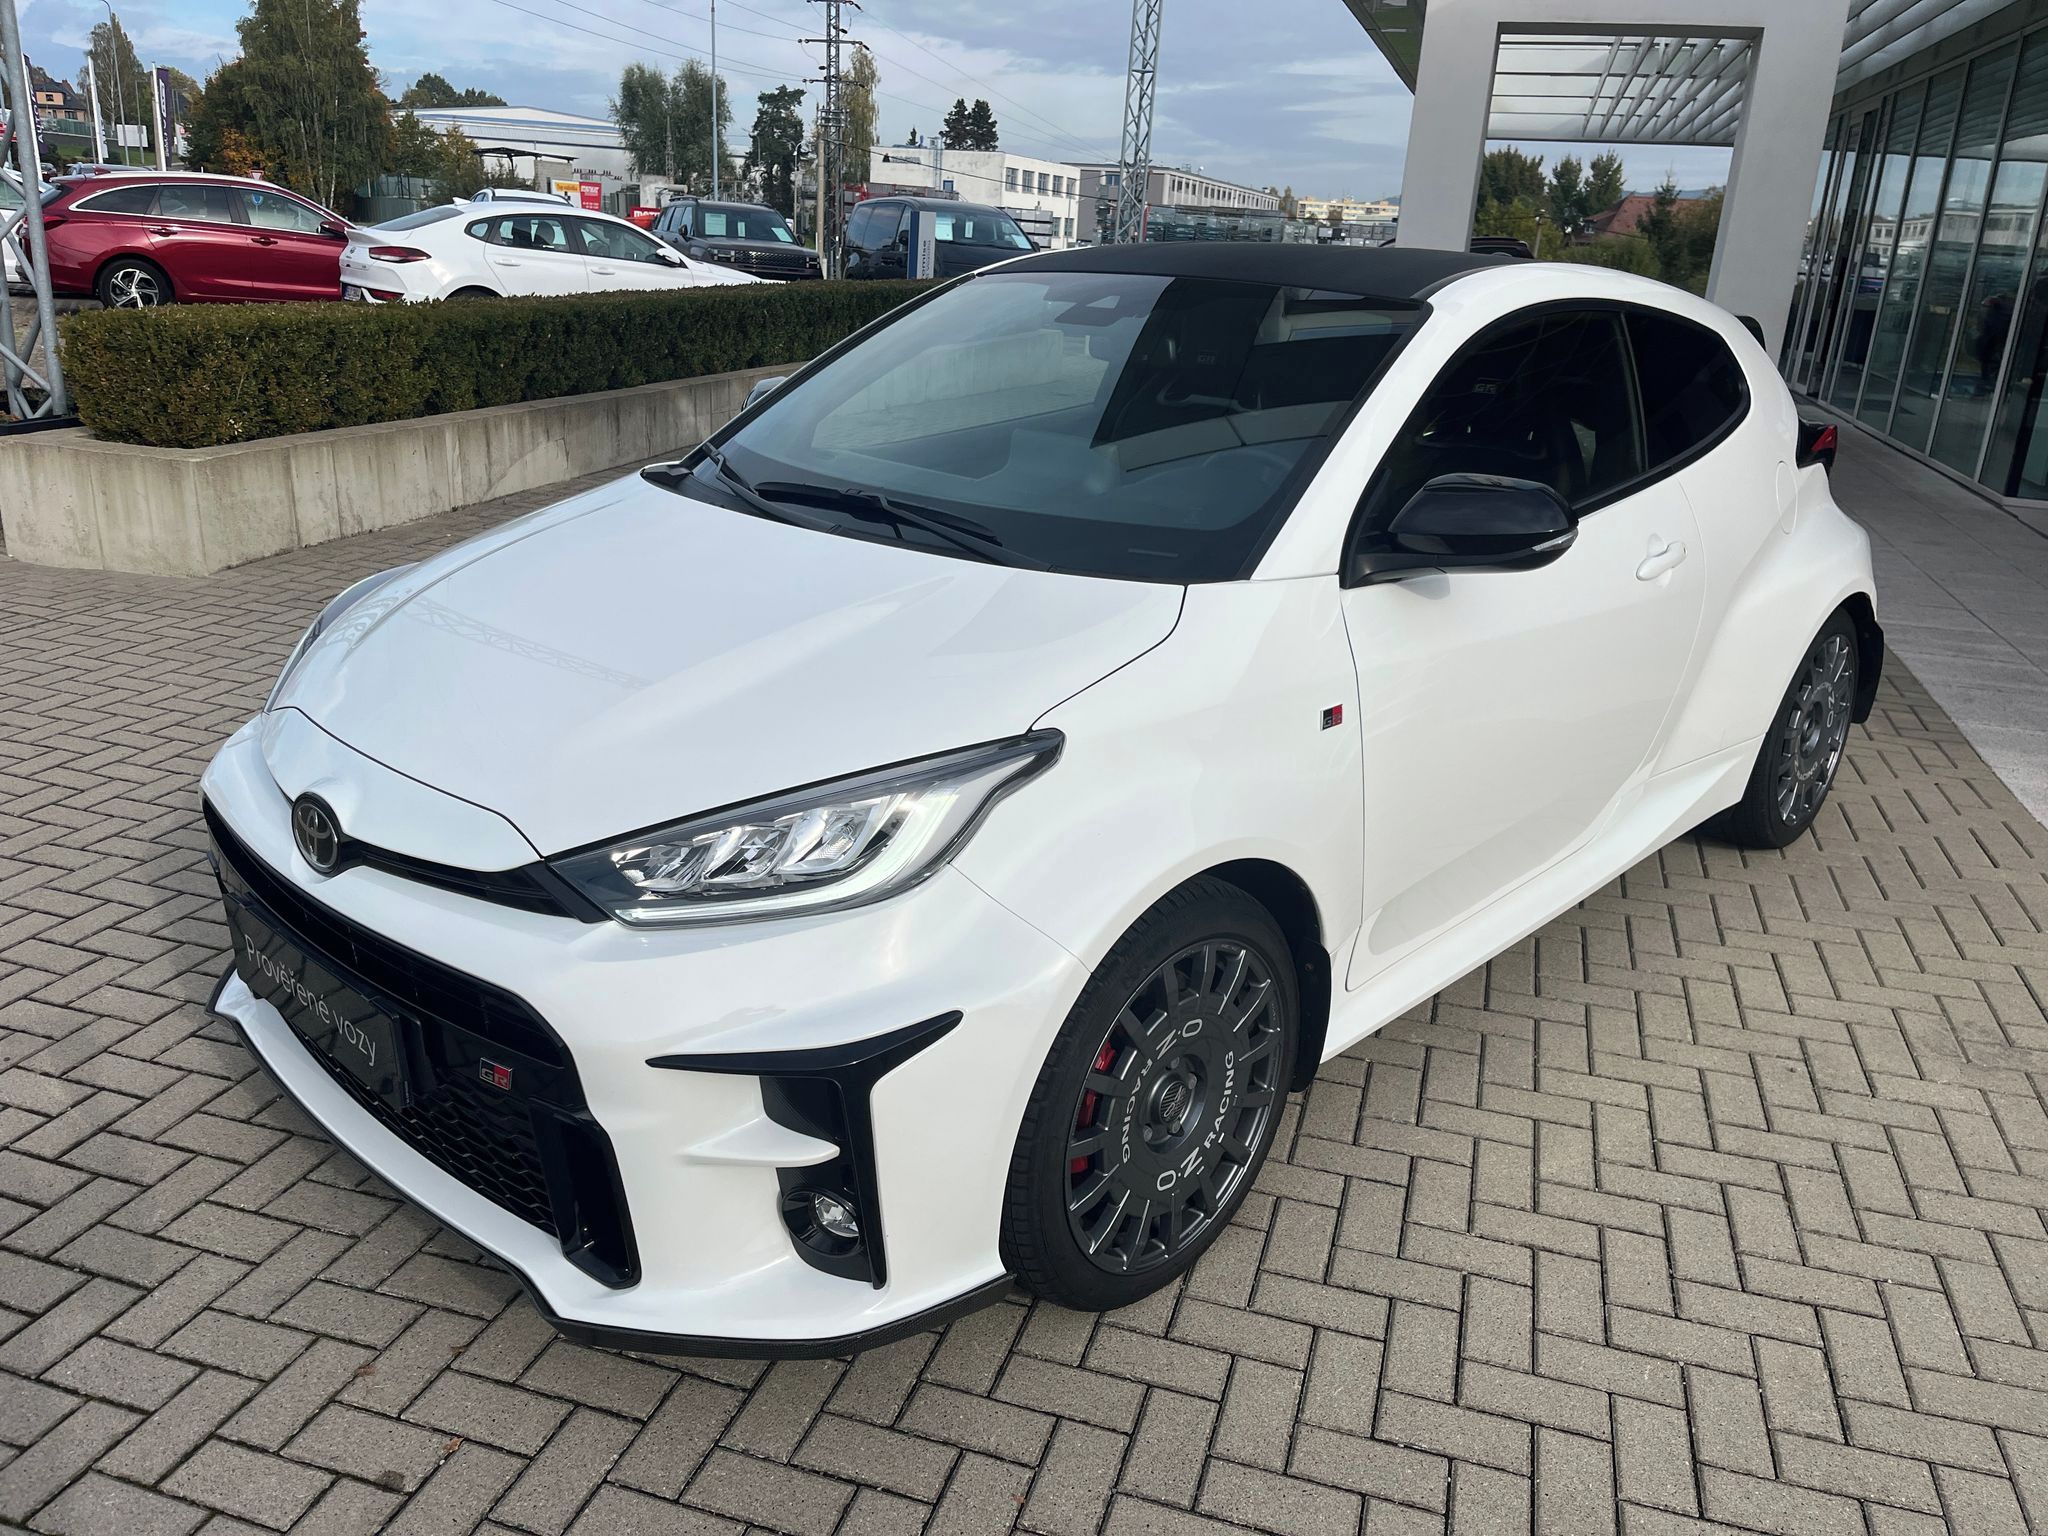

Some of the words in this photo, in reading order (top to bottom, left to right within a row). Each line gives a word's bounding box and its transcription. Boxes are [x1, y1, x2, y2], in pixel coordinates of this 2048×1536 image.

[245, 934, 330, 1023] Prověřené
[333, 1008, 377, 1067] vozy
[481, 1067, 509, 1088] GR
[1122, 1058, 1153, 1164] RACING
[1203, 1050, 1235, 1150] RACING
